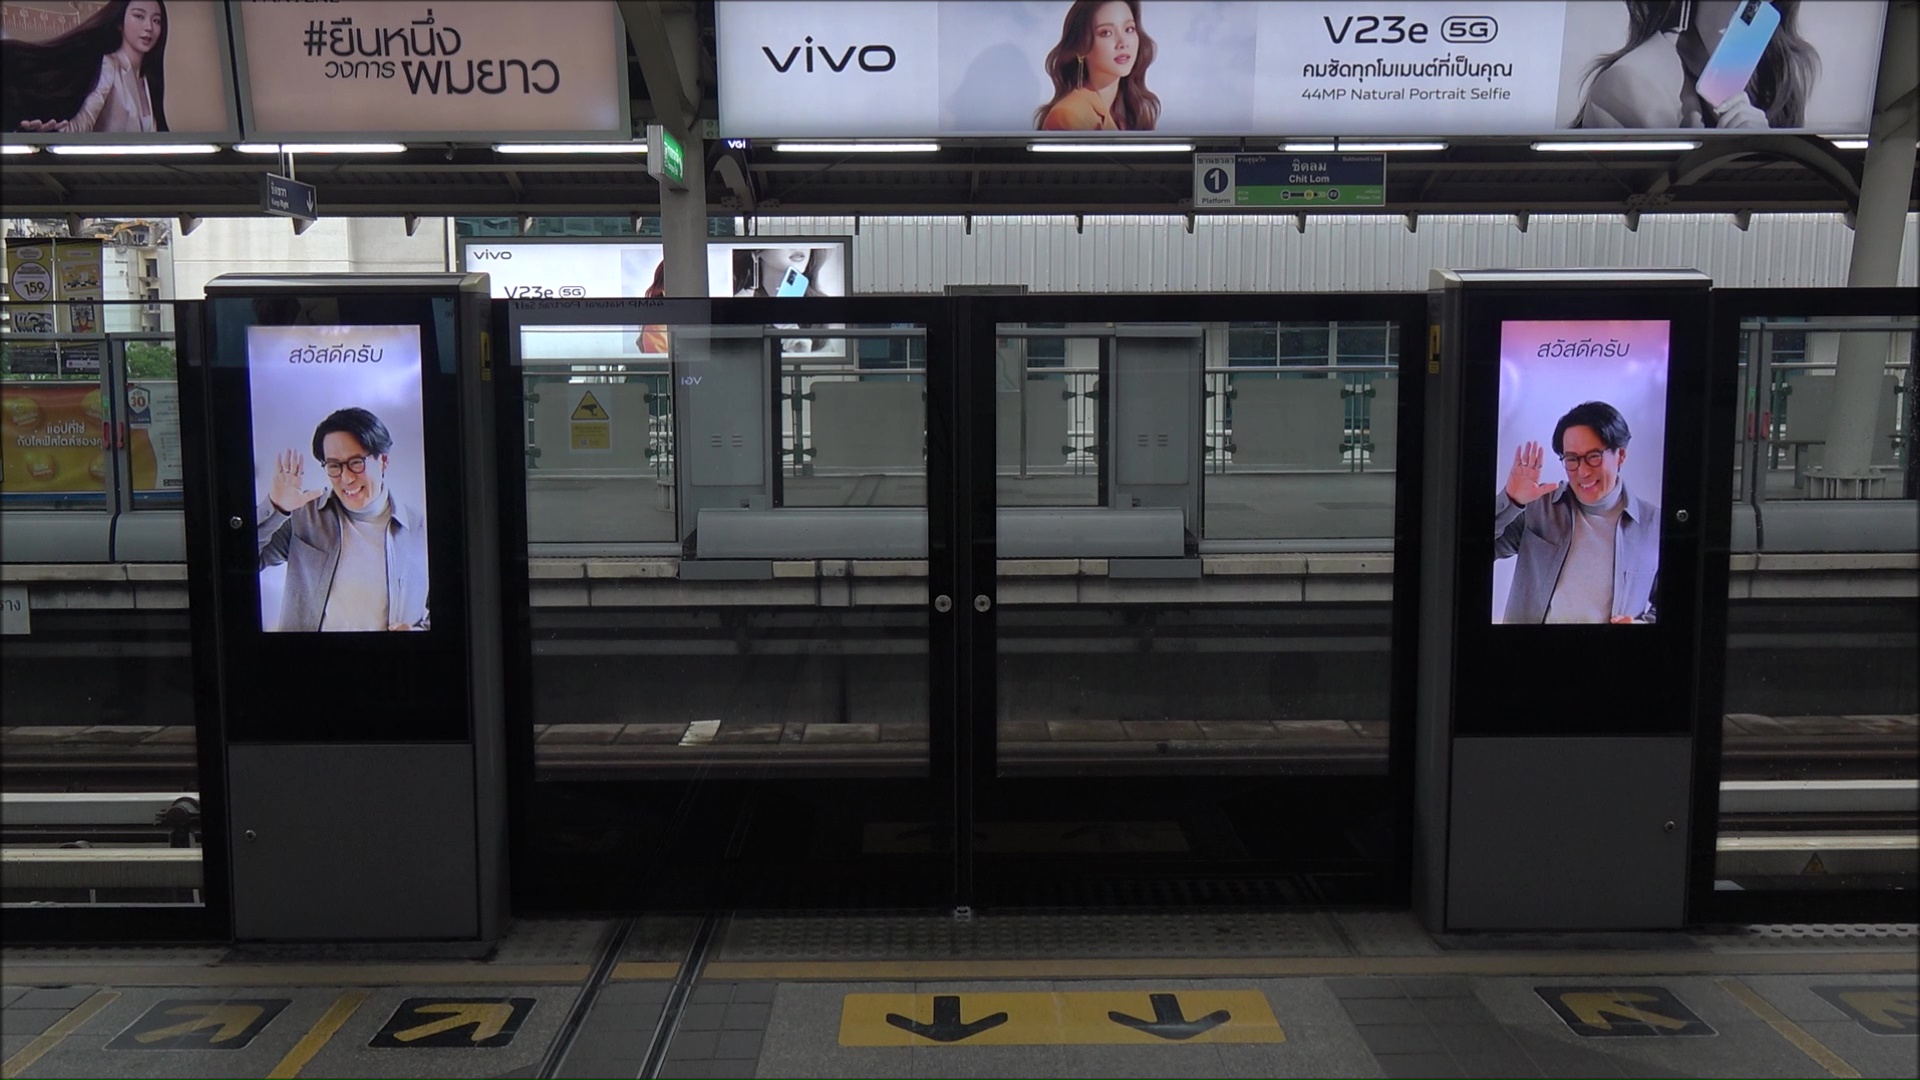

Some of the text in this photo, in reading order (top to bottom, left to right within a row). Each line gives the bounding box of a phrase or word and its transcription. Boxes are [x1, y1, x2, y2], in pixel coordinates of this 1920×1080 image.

[304, 8, 462, 57] #ยืนหนึ่ง
[1323, 15, 1489, 44] V23e 5G
[761, 35, 897, 73] vivo
[324, 59, 561, 95] วงการ ผมยาว
[1302, 52, 1513, 83] คมชัดทุกโมเมนต์ที่เป็นคุณ
[1301, 87, 1511, 100] 44MP Natural Portrait Selfie
[1292, 158, 1327, 173] ชิดลม
[1209, 169, 1221, 191] 1
[1288, 174, 1330, 184] Chit Lom
[473, 249, 513, 260] vivo
[24, 281, 46, 297] 159
[503, 285, 583, 299] V23e 5G
[288, 343, 384, 364] สวัสดีครับ
[1537, 338, 1630, 358] สวัสดีครับ
